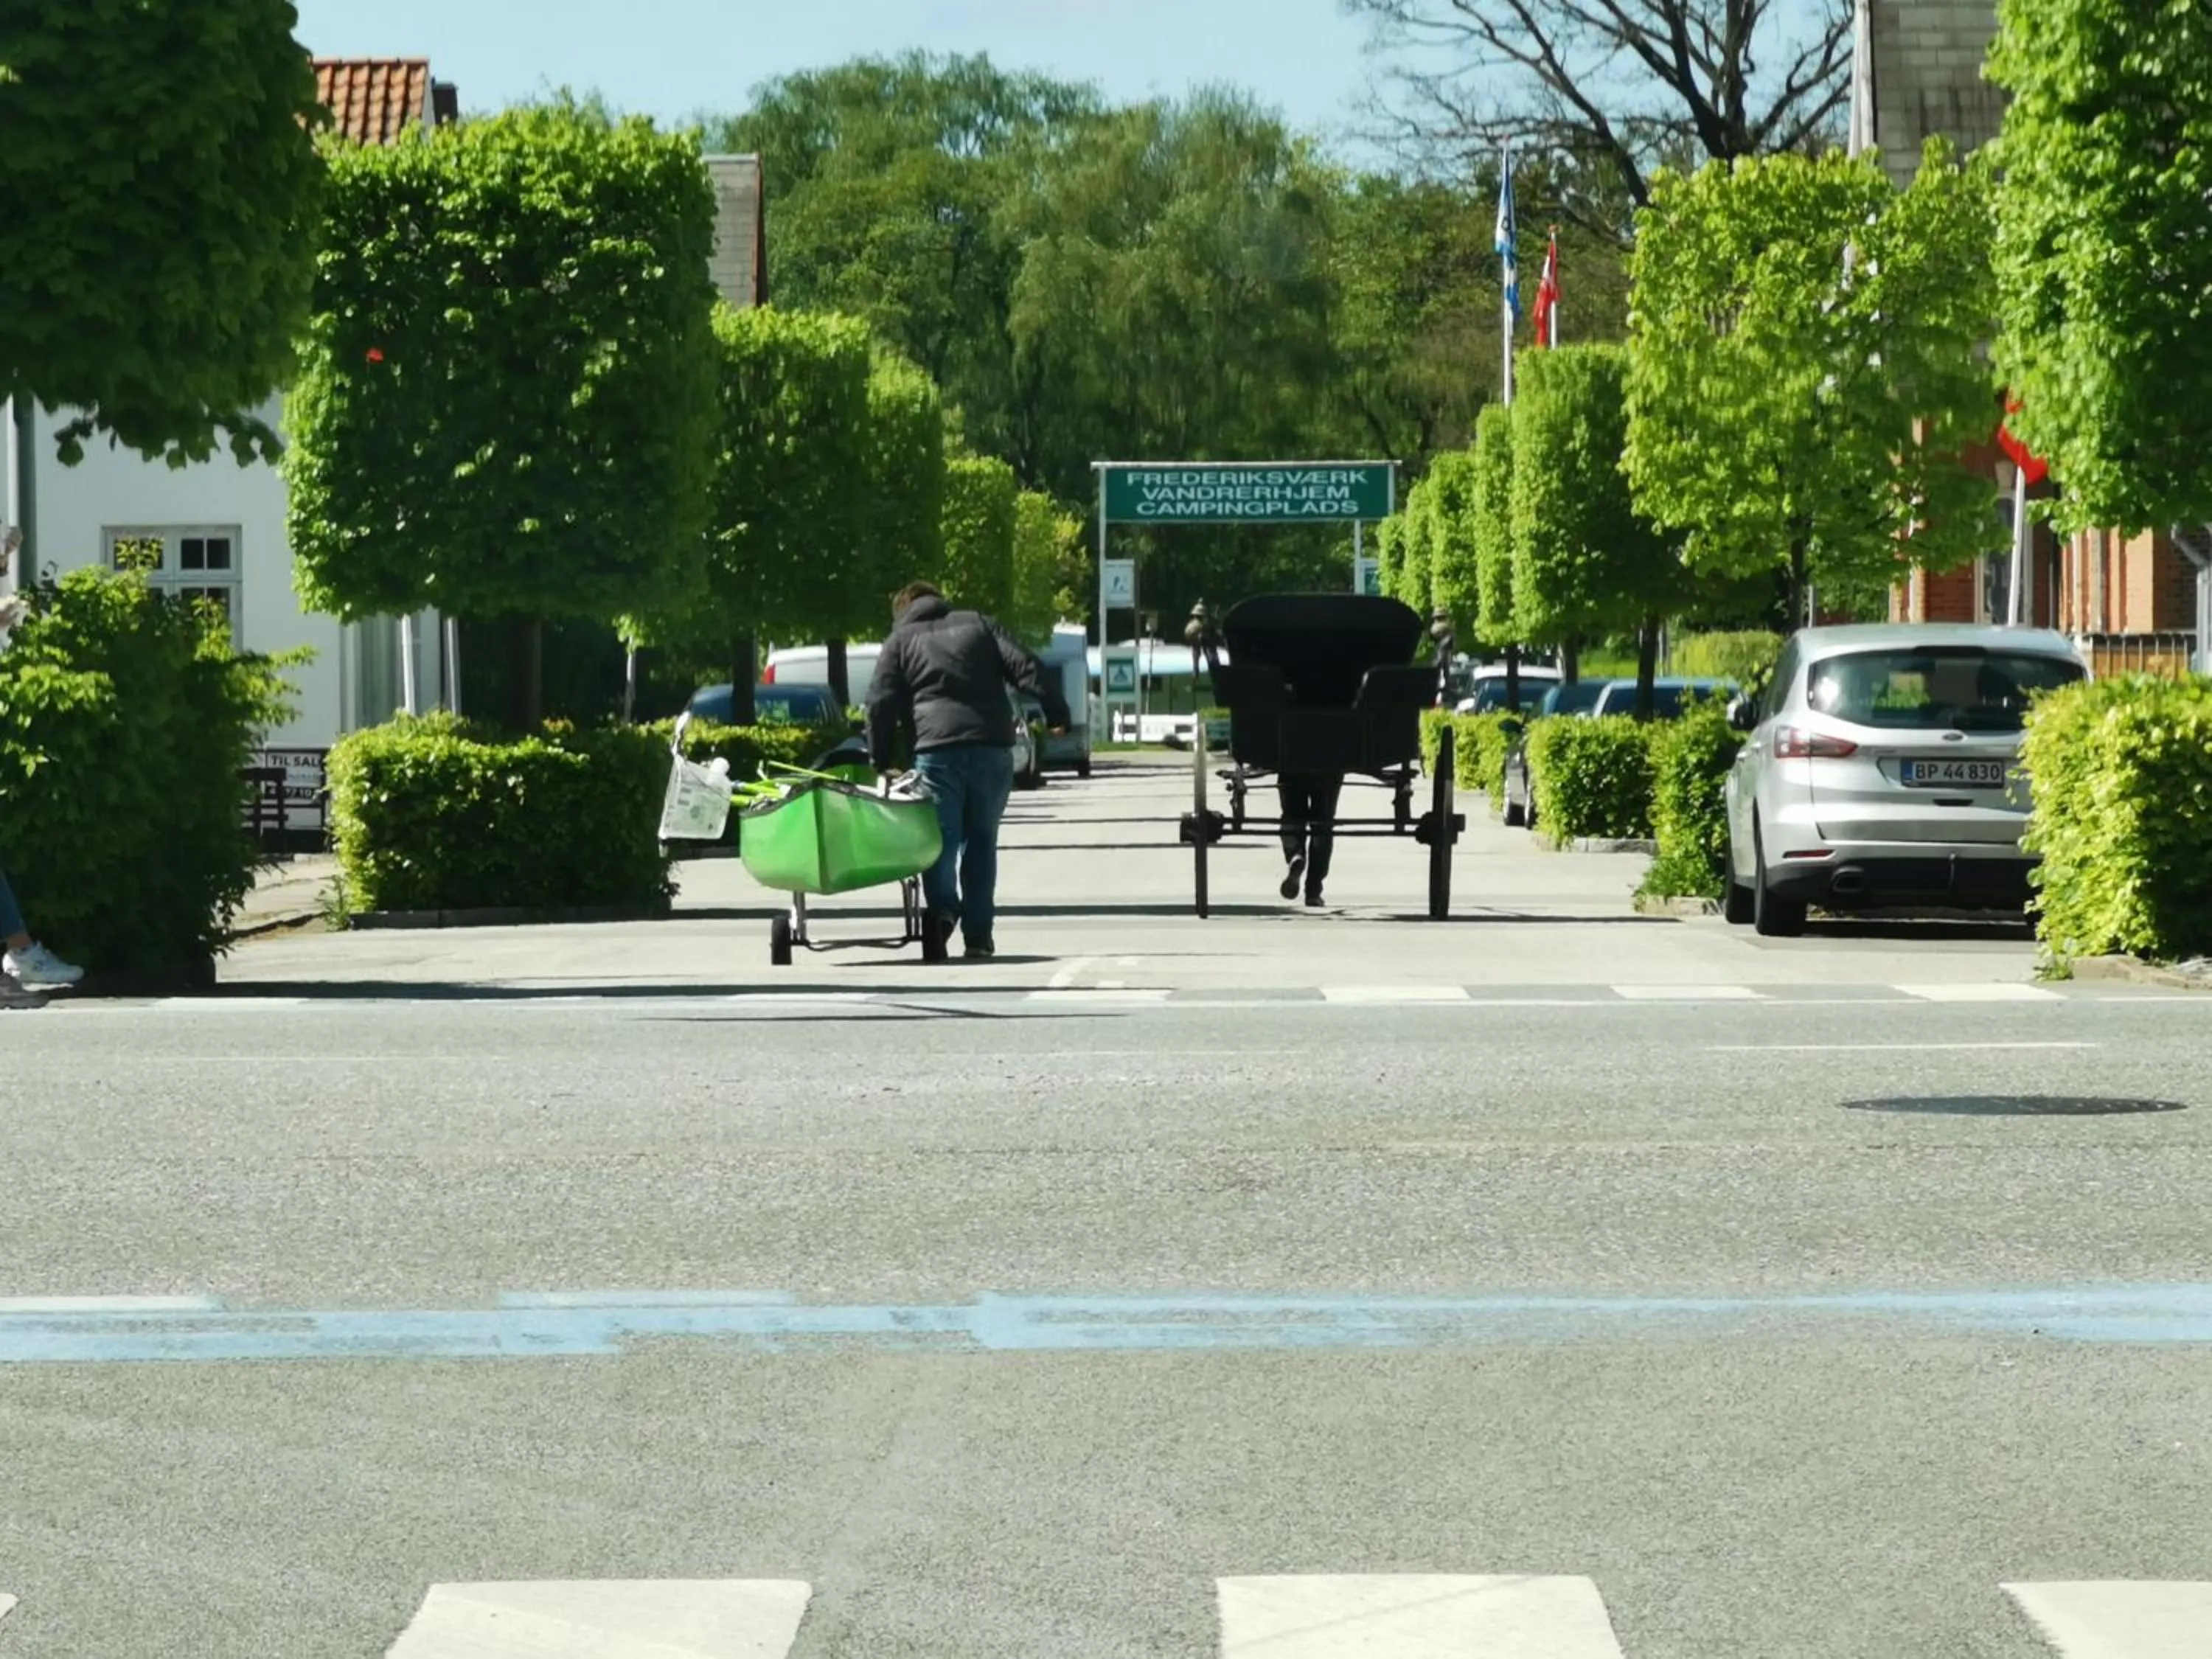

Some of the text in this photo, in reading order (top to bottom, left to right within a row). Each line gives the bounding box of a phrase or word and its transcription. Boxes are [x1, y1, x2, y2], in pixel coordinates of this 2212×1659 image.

[1127, 470, 1368, 486] FREDERIKSVÆRK
[1141, 485, 1350, 501] VANDRERHJEM
[1135, 500, 1360, 515] CAMPINGPLADS
[271, 755, 321, 768] TIL SAL
[1916, 763, 2000, 780] BP 44 830
